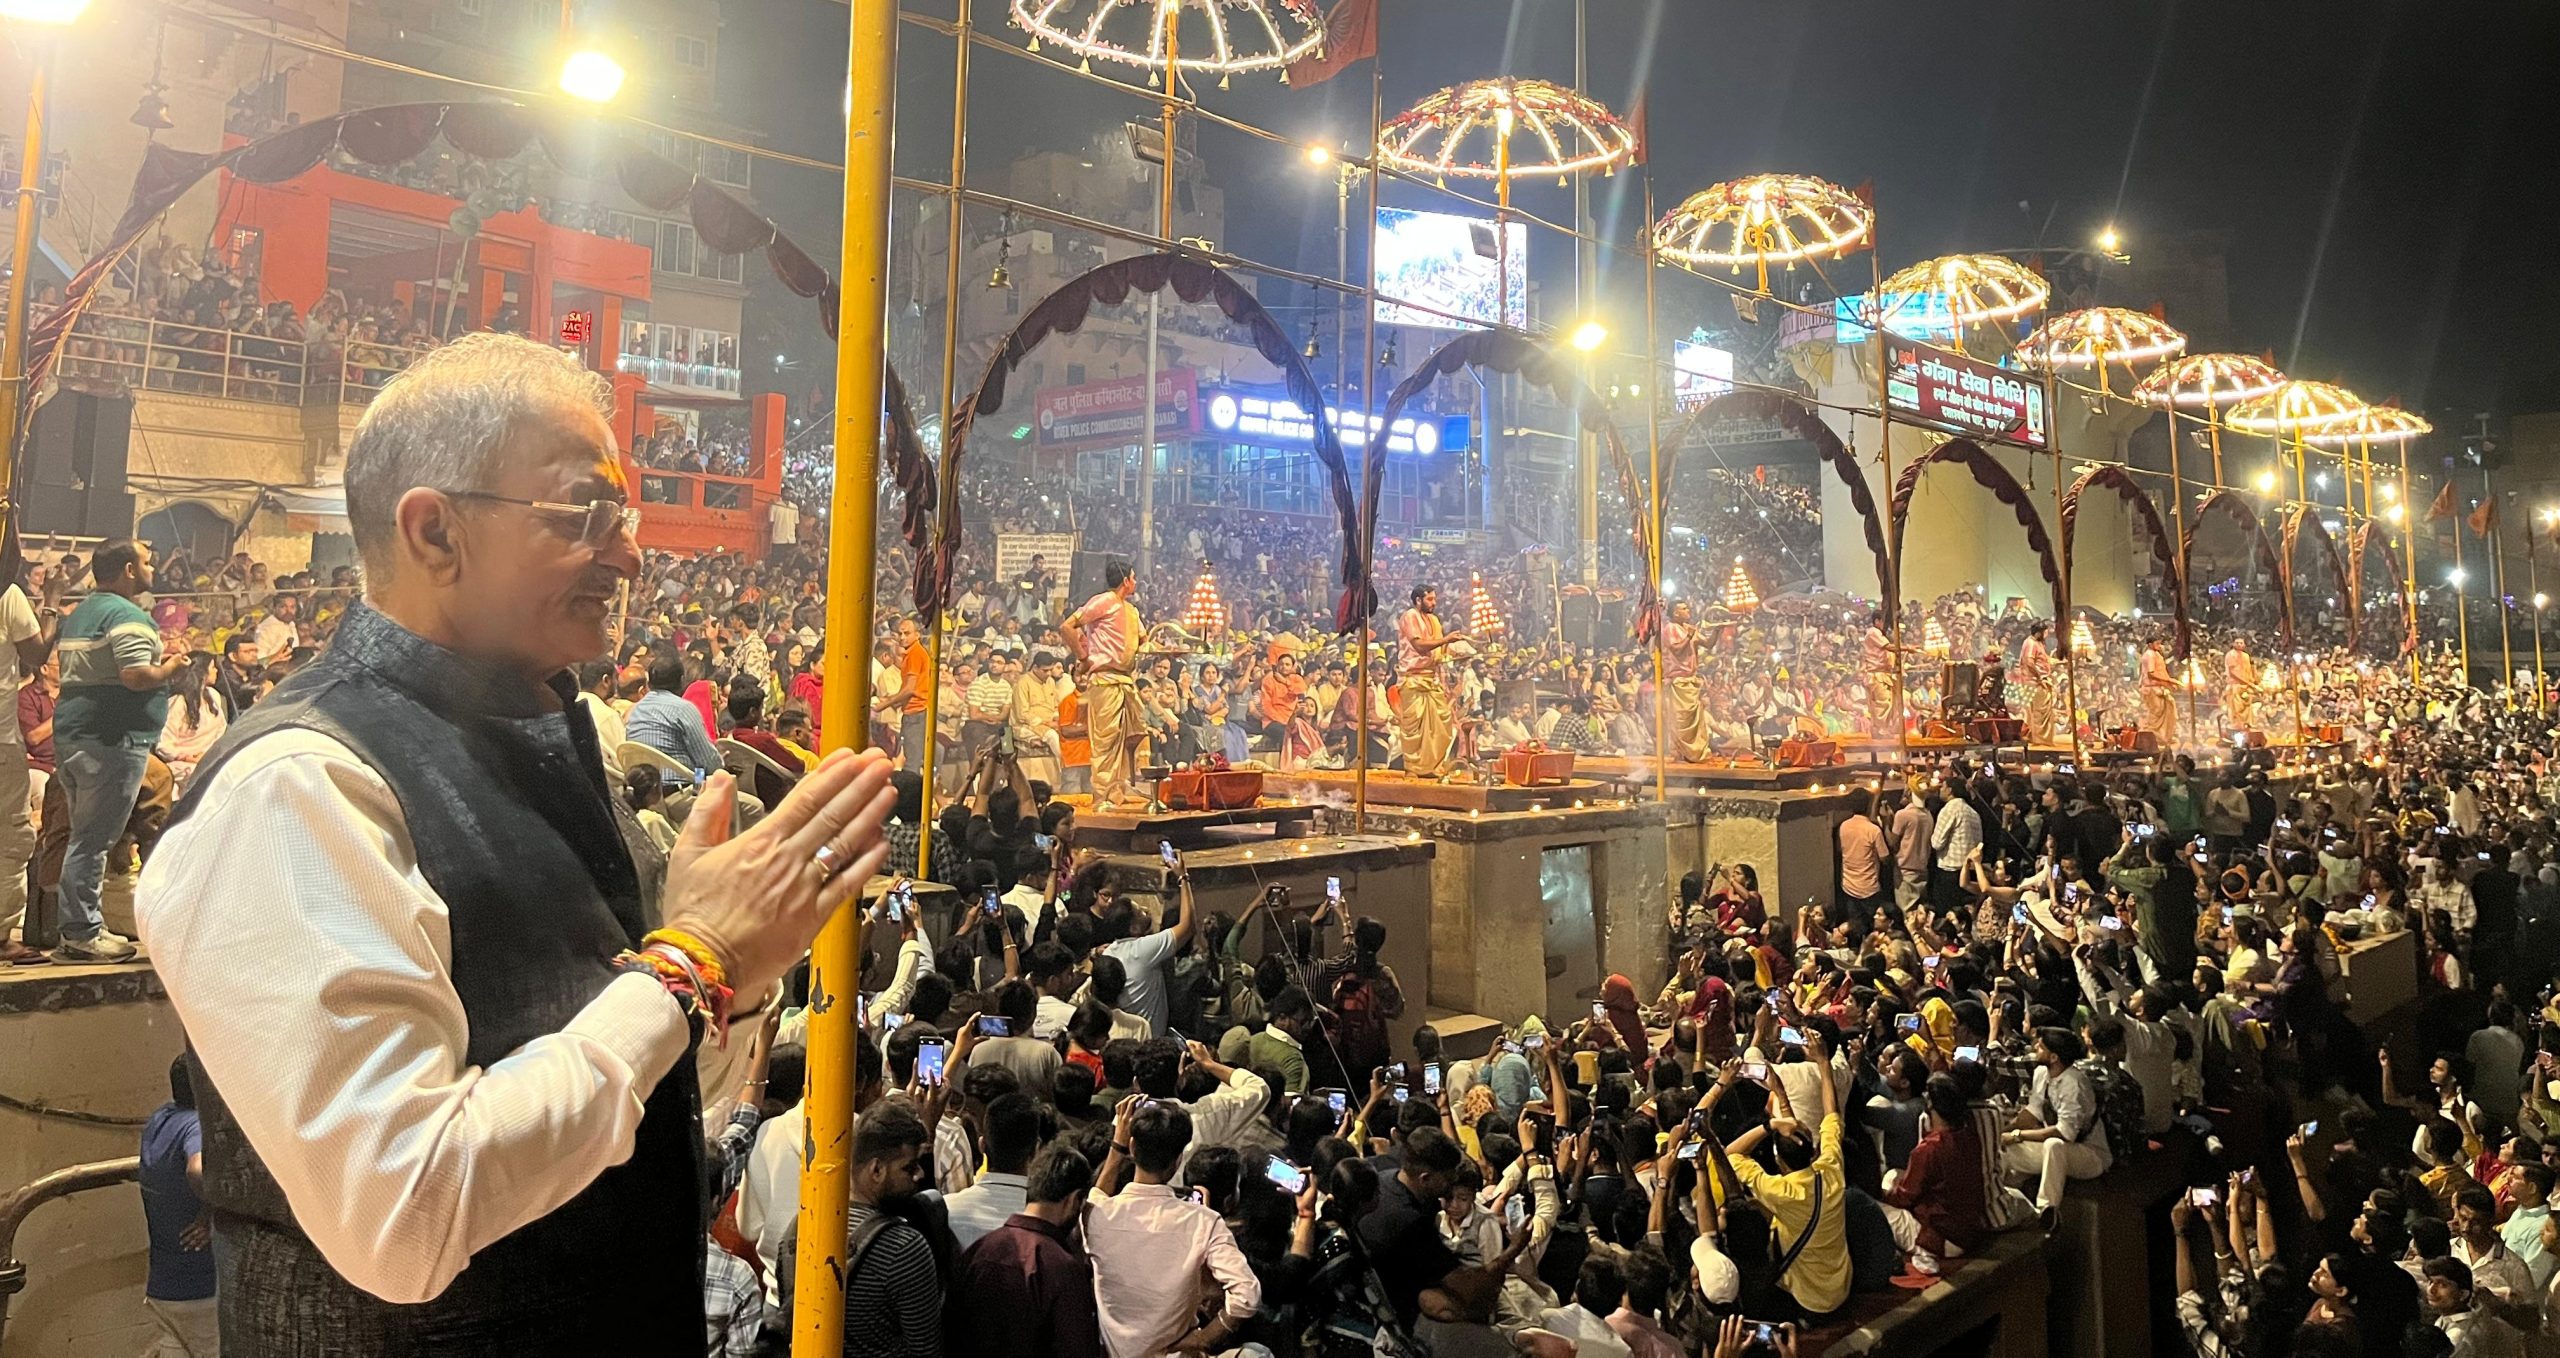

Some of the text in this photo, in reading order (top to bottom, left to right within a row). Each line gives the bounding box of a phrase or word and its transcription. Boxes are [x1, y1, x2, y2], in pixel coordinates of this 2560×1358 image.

[1922, 357, 1958, 387] गंगा
[1959, 367, 1990, 397] सेवा
[1991, 375, 2025, 405] निधि
[1070, 422, 1090, 438] POLICE
